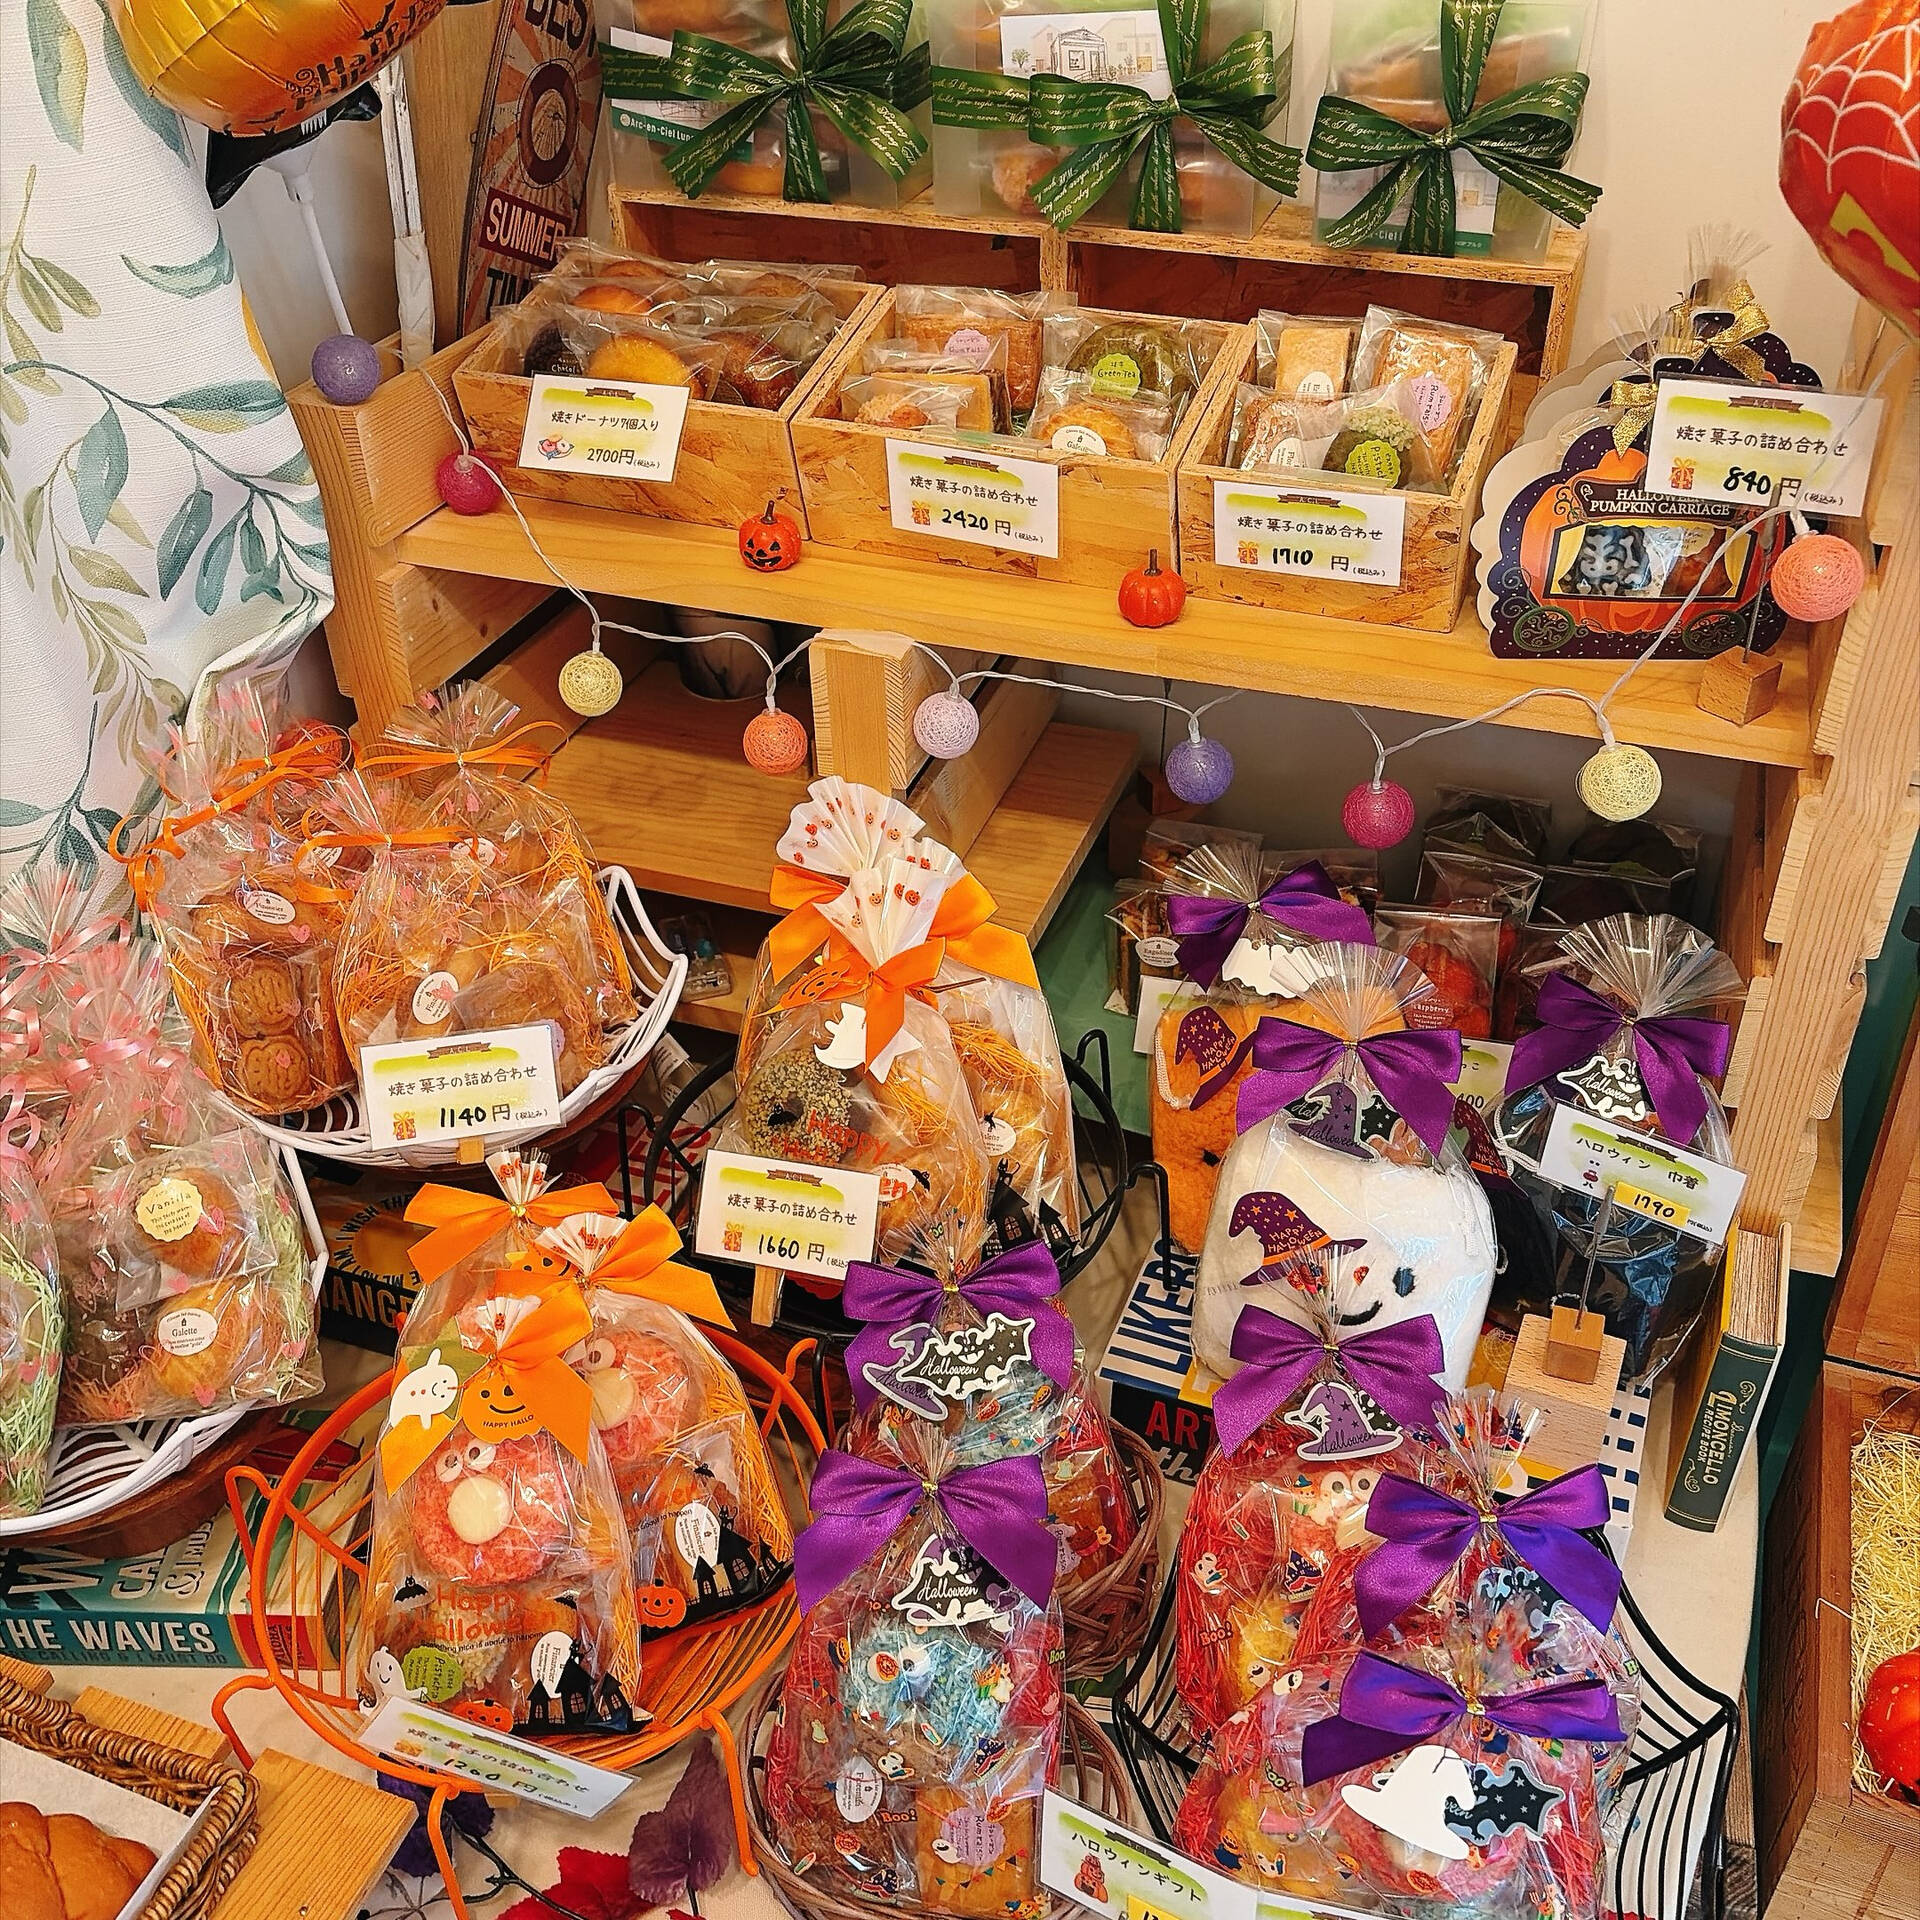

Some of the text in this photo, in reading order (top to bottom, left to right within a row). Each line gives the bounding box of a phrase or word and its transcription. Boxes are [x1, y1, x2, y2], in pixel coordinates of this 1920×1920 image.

[1097, 368, 1136, 378] Green Tea
[551, 410, 660, 432] 焼きドーナツ7個入り
[1676, 425, 1849, 457] 焼き菓子の詰め合わせ
[909, 475, 1039, 507] 焼き菓子の詰め合わせ
[1722, 466, 1771, 495] 840
[941, 508, 988, 531] 2420
[1589, 499, 1730, 516] PUMPKIN CARRIAGE
[1237, 516, 1384, 541] 焼き菓子の詰め合わせ
[1272, 547, 1314, 566] 1710
[1201, 1036, 1236, 1071] HALLOWEEN
[1202, 1033, 1226, 1058] HAPPY
[388, 1066, 538, 1096] 焼き菓子の詰め合わせ
[1579, 1071, 1633, 1103] Halloween
[440, 1106, 487, 1128] 1140
[1301, 1122, 1361, 1148] Halloween
[1577, 1137, 1700, 1191] ハロウィン 巾着
[146, 1192, 192, 1215] Vanilla
[727, 1194, 858, 1226] 焼き菓子の詰め合わせ
[1633, 1193, 1675, 1218] 1790
[1268, 1229, 1323, 1254] HALLOWEEN
[1269, 1224, 1305, 1242] HAPPY
[758, 1234, 800, 1260] 1660
[920, 1354, 980, 1377] Halloween
[483, 1414, 534, 1429] HAPPY HALLO
[1317, 1429, 1379, 1456] Halloween
[1697, 1408, 1714, 1463] RECIPE BOOK
[1702, 1390, 1738, 1486] LIMONCELLO
[435, 1583, 522, 1616] Happy
[917, 1576, 979, 1601] Halloween
[0, 1619, 217, 1653] HE WAVES
[1200, 1620, 1234, 1648] Boo!
[880, 1807, 917, 1823] Boo!
[1072, 1832, 1202, 1903] ハロウィンギフト
